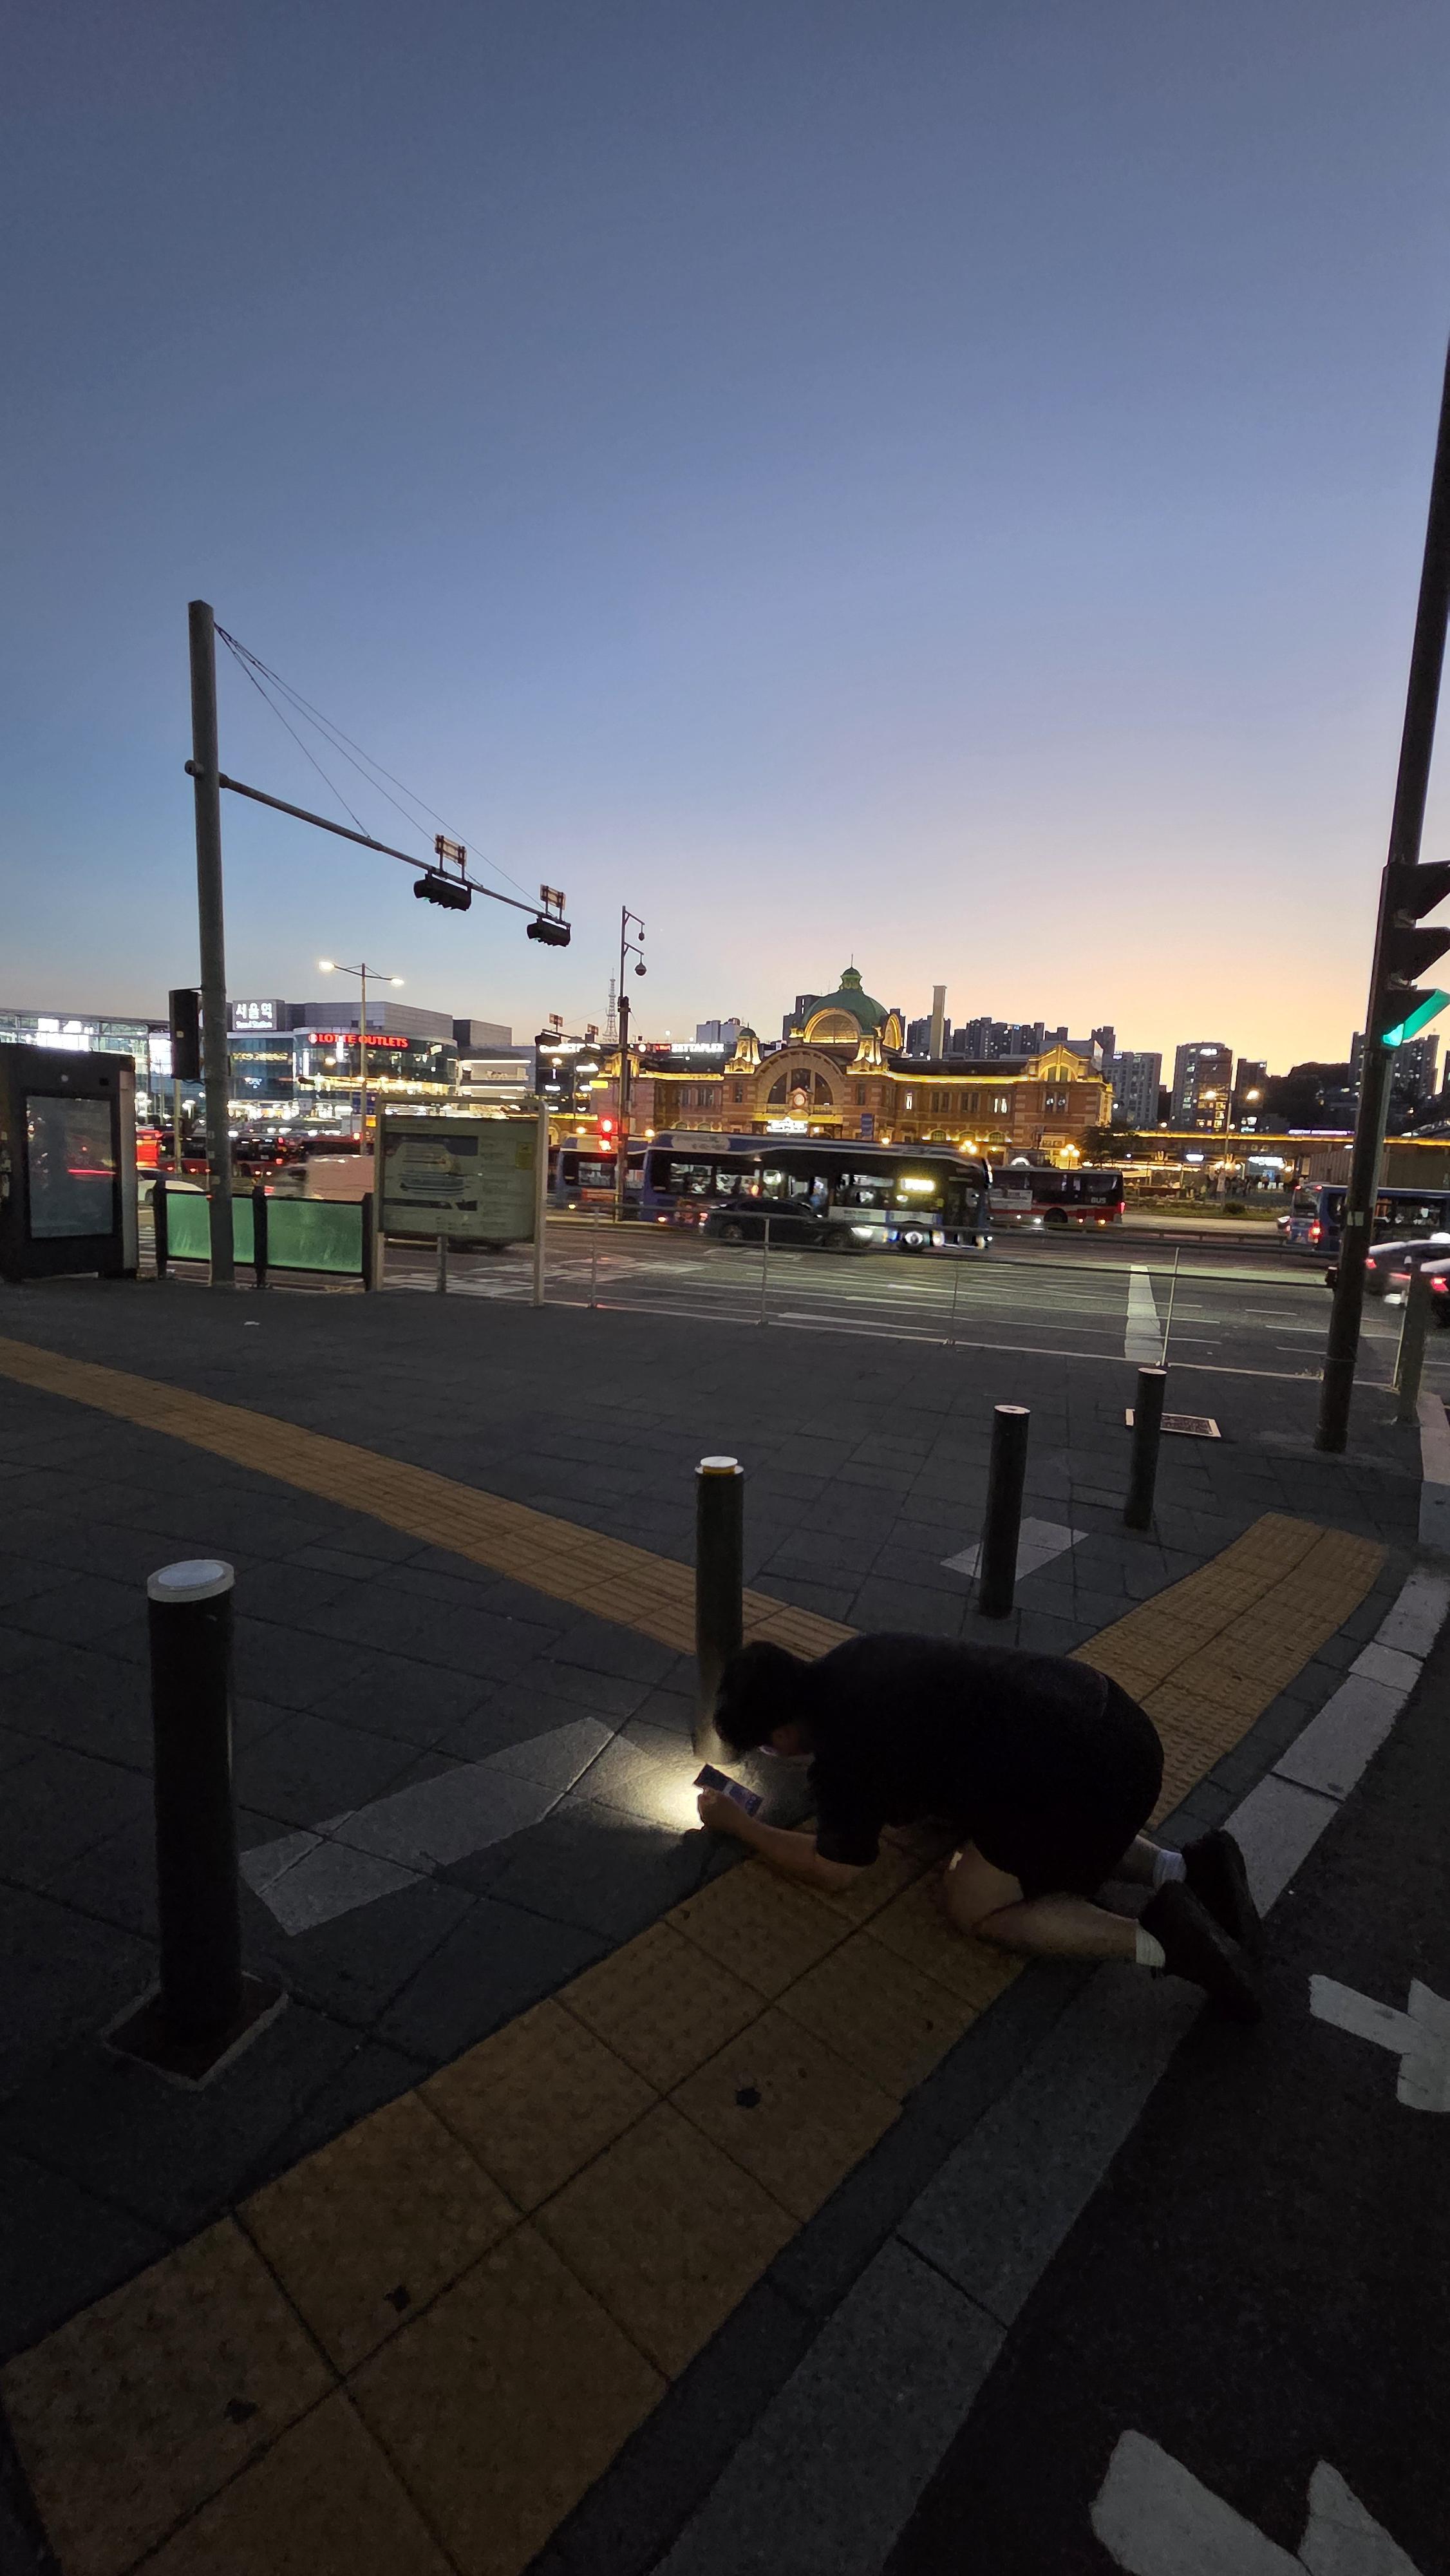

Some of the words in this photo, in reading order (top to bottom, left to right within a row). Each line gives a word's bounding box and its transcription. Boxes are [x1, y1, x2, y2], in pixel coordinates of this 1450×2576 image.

[235, 1002, 273, 1019] 서울역
[319, 1034, 356, 1043] LOTTE
[358, 1035, 408, 1048] OUTLETS
